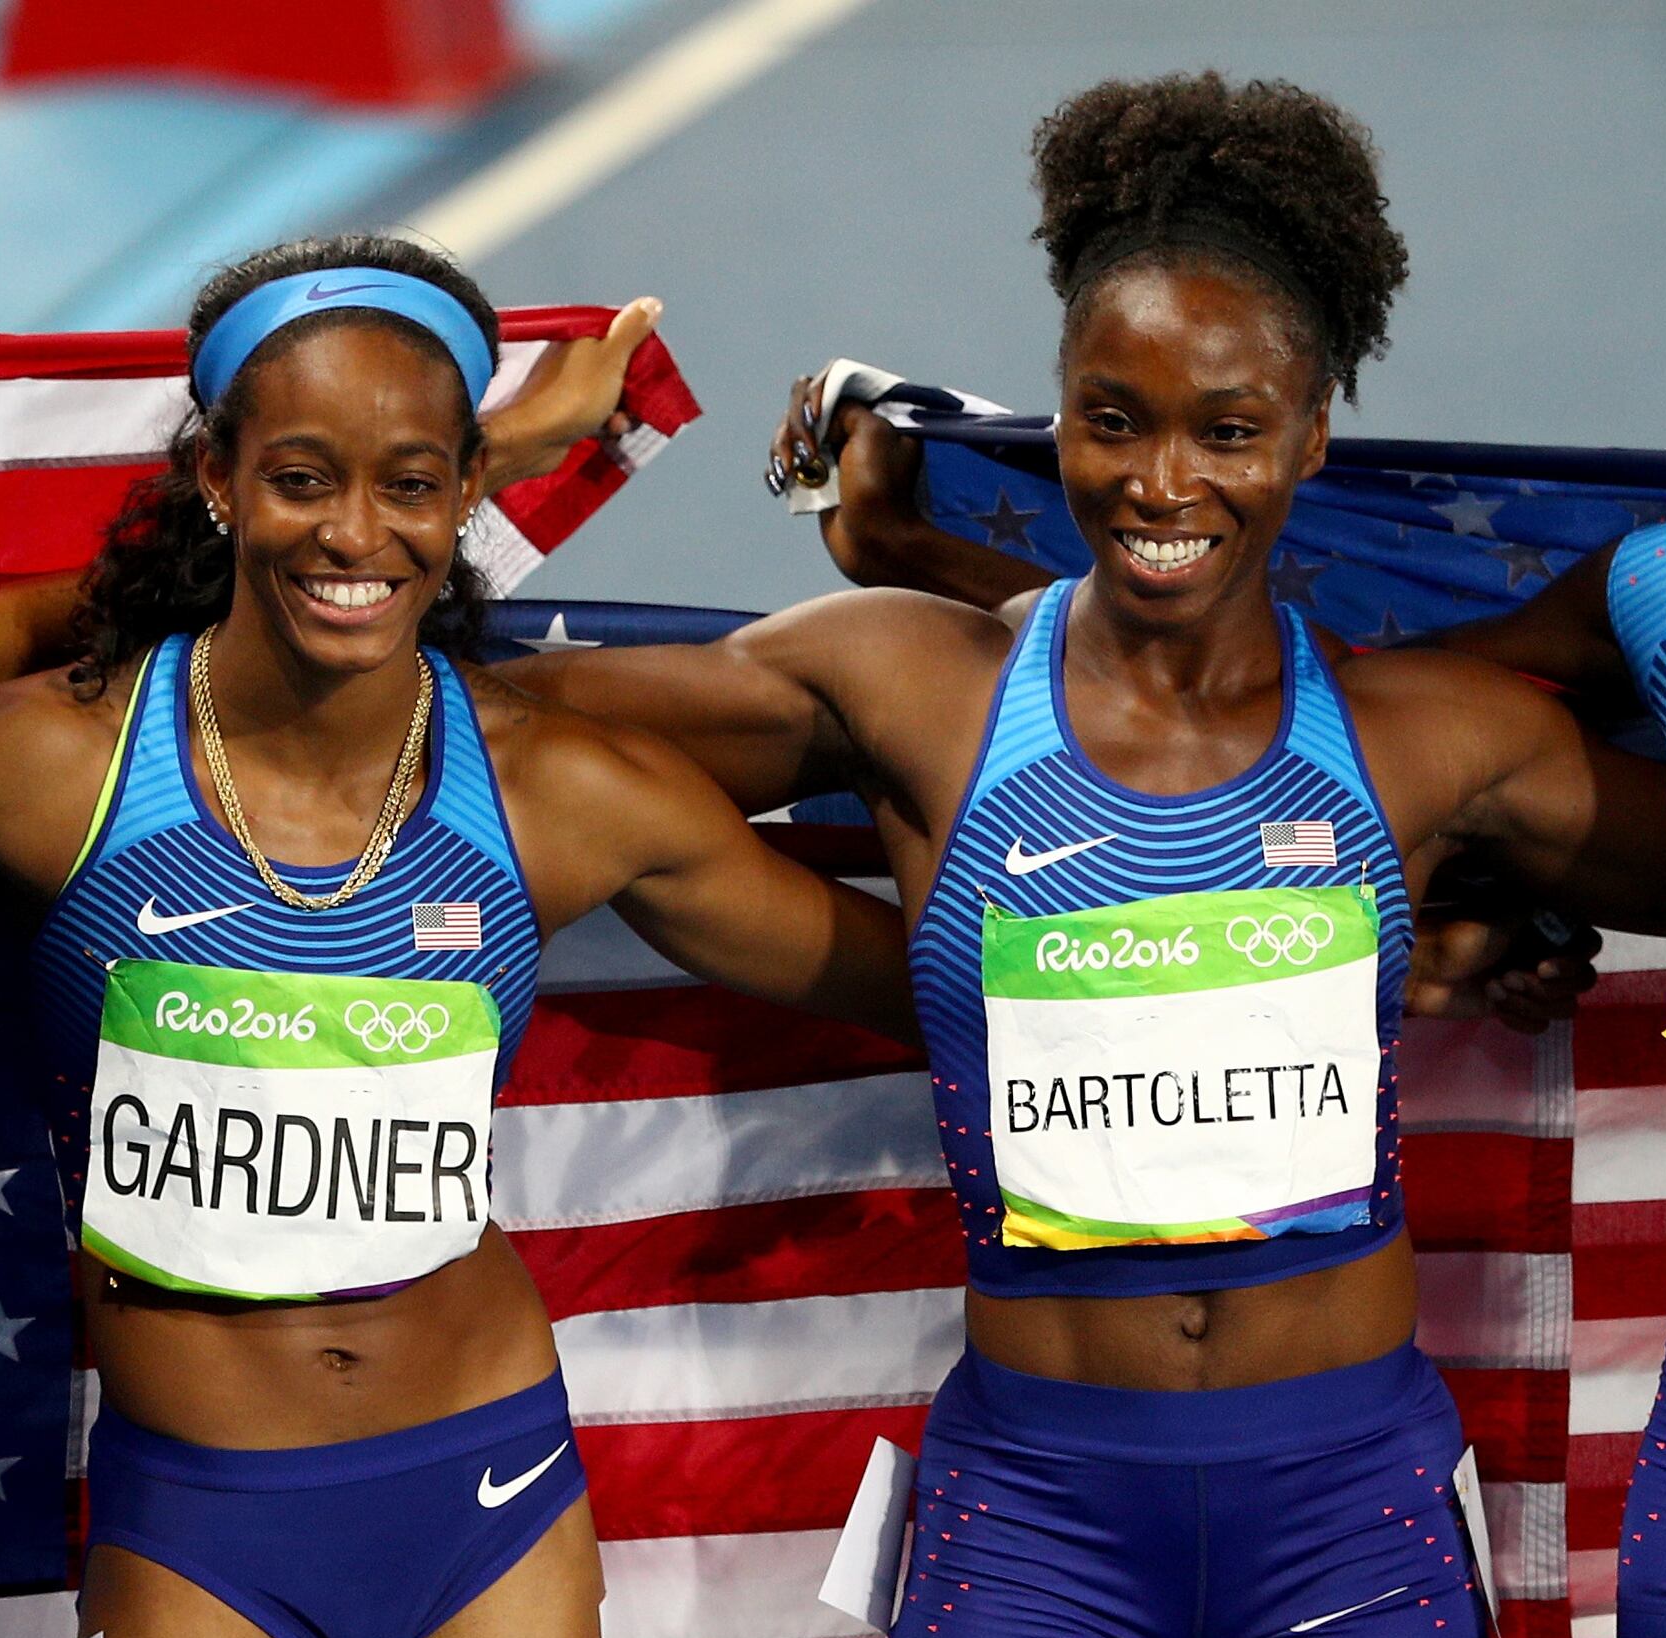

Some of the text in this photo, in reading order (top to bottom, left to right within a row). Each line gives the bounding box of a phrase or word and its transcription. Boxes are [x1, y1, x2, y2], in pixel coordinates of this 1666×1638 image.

[1035, 925, 1200, 973] Rio2016
[155, 991, 317, 1042] Rio2016
[1006, 1062, 1349, 1134] BARTOLETTA
[103, 1093, 479, 1224] GARDNER
